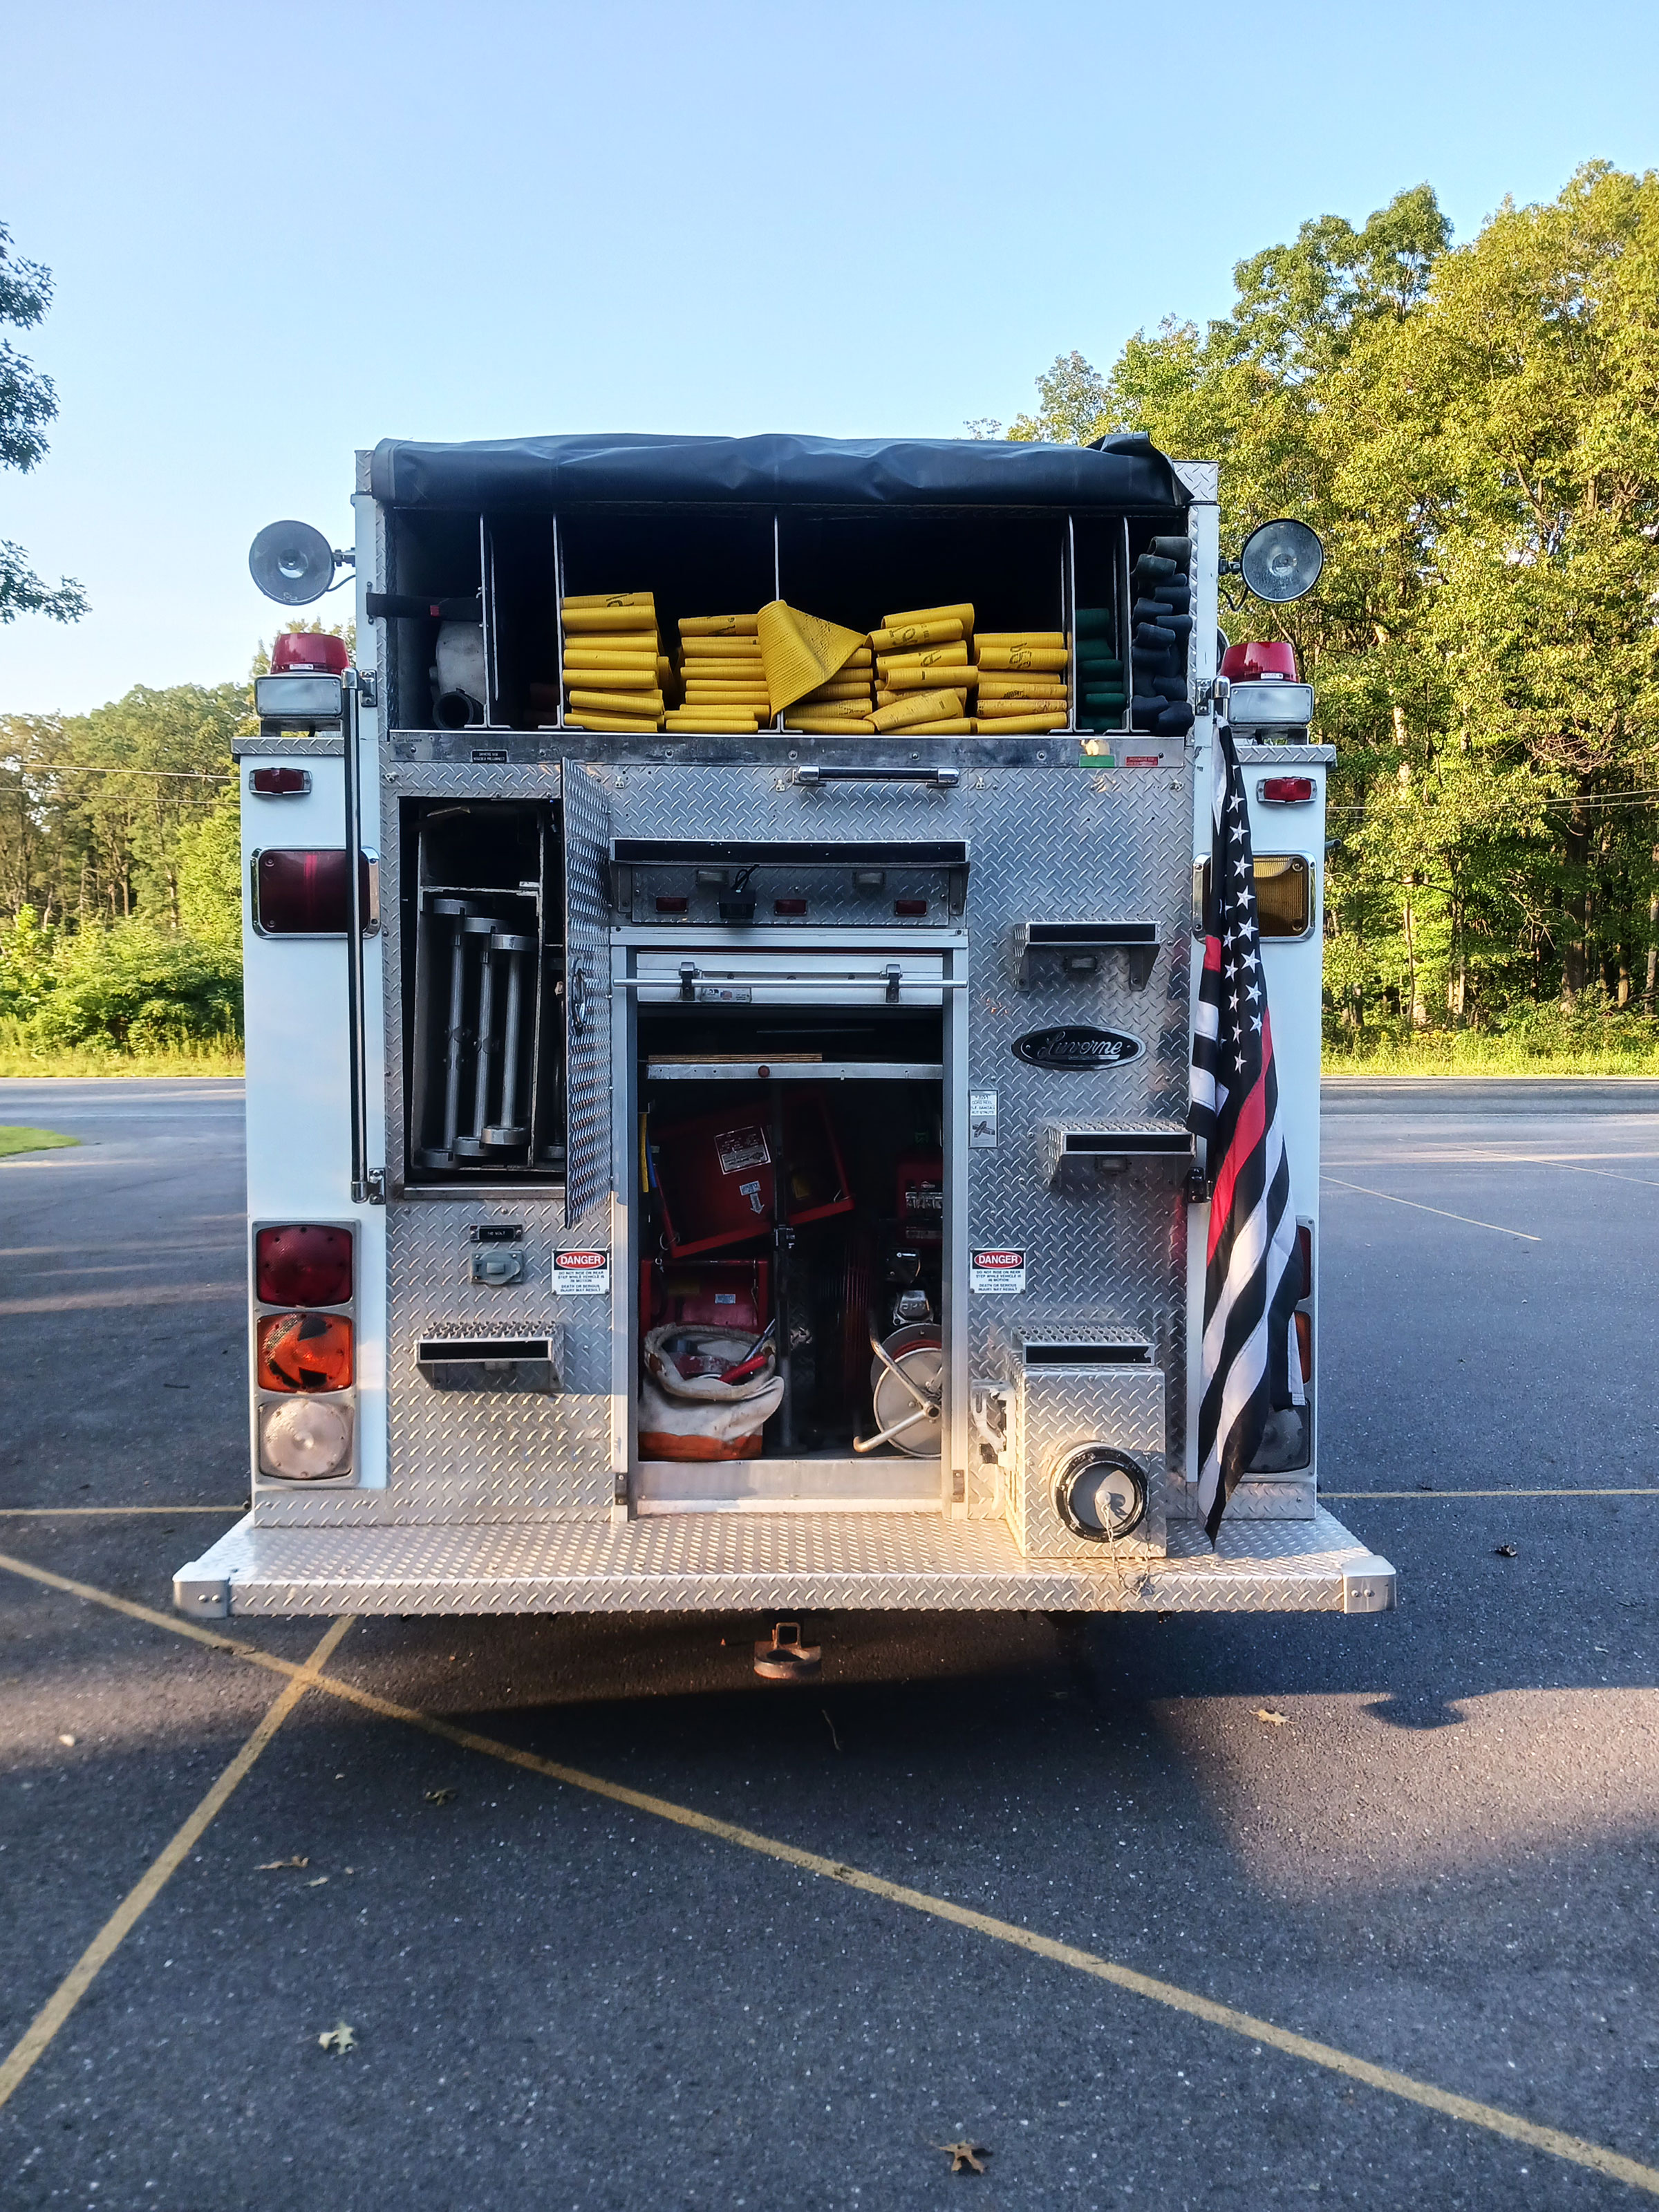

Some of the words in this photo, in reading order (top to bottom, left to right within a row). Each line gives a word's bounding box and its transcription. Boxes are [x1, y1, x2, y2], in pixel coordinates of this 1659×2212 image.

[1037, 1031, 1123, 1056] Luverne
[560, 1255, 601, 1265] DANGER
[978, 1255, 1018, 1264] DANGER
